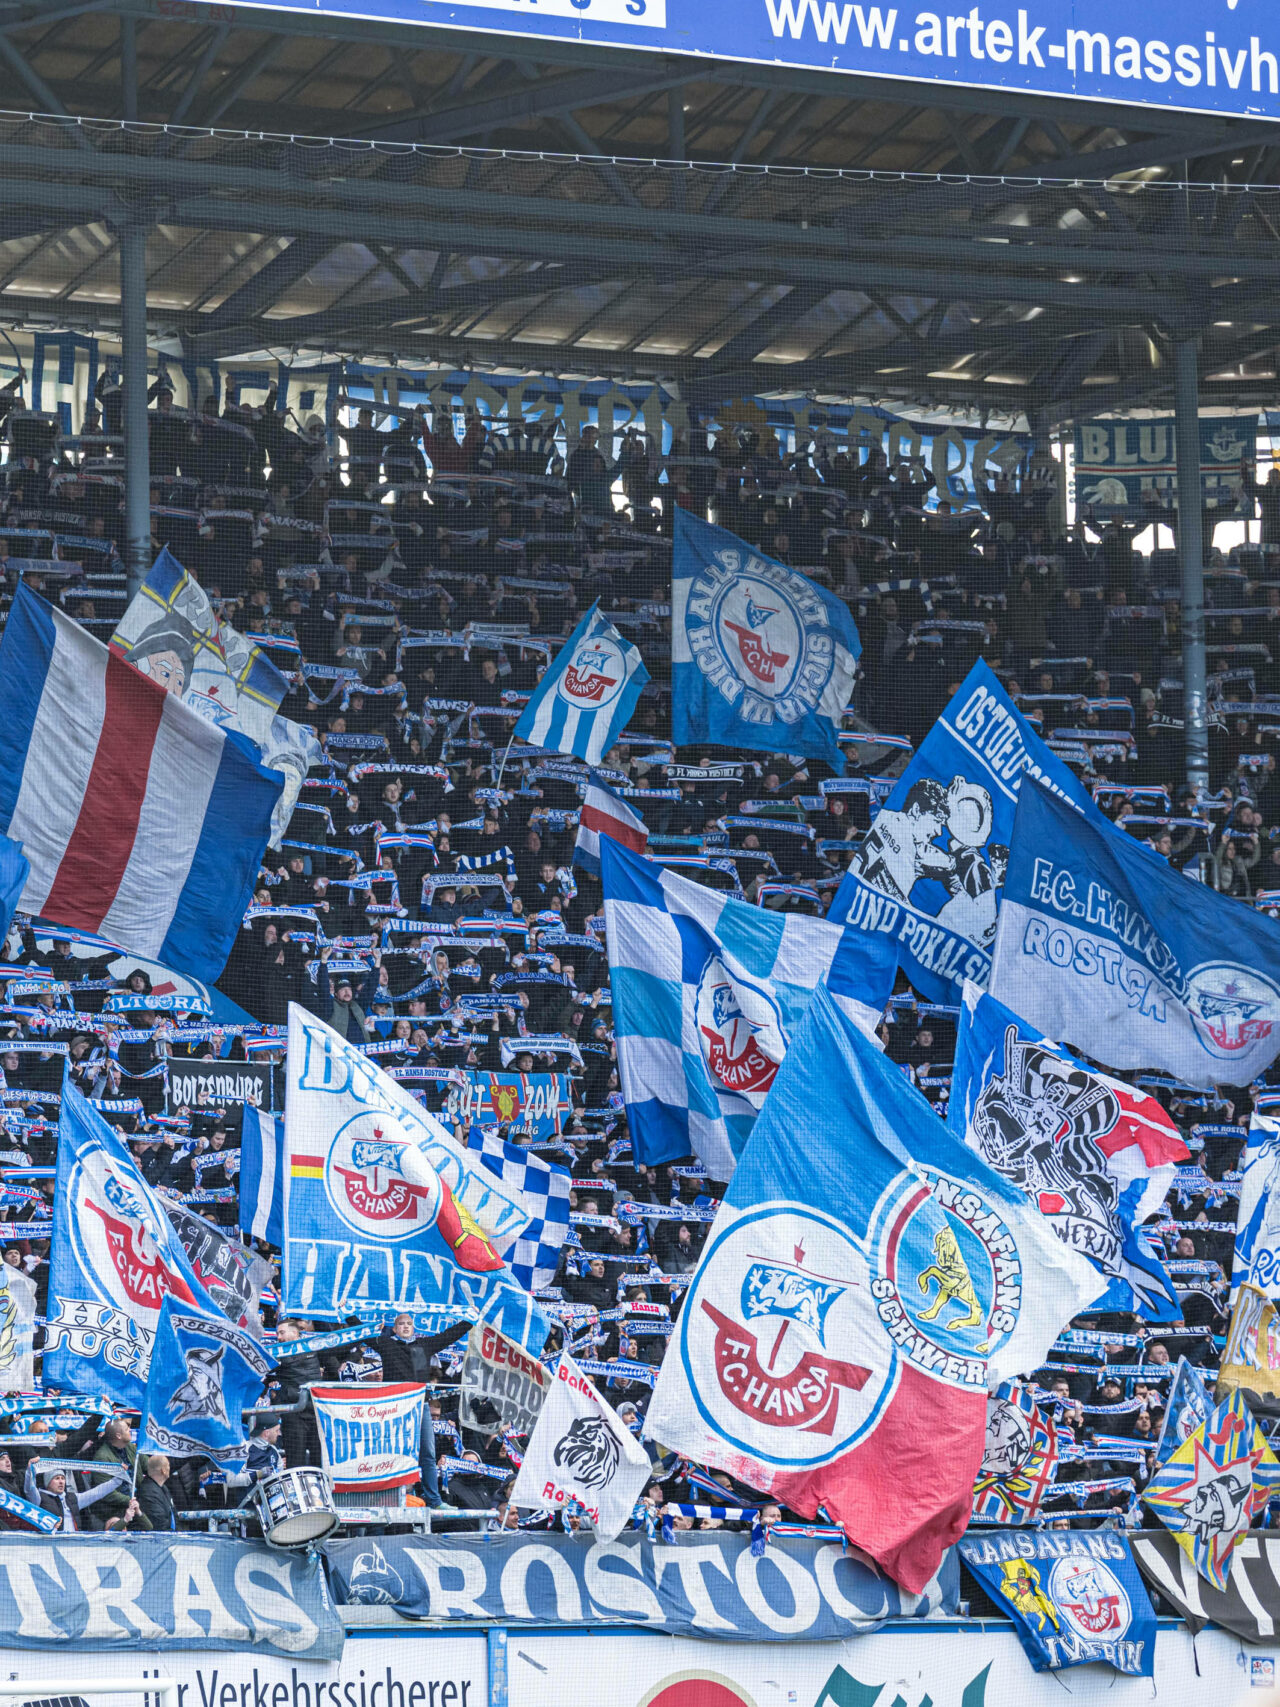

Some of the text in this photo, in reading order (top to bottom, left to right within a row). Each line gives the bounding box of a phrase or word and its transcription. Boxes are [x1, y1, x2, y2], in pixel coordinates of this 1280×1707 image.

[878, 823, 902, 856] Hansa
[846, 886, 901, 942] UND
[405, 1069, 422, 1077] HANSA
[424, 1069, 449, 1078] ROSTOCK
[524, 1085, 561, 1121] ZOW
[631, 1303, 659, 1313] Hansa
[171, 1315, 271, 1376] SUPTRAS
[482, 1327, 544, 1384] GEGEN
[350, 1404, 398, 1420] The Original
[404, 1545, 925, 1632] ROSTOC
[197, 1667, 471, 1707] Verkehrssicherer
